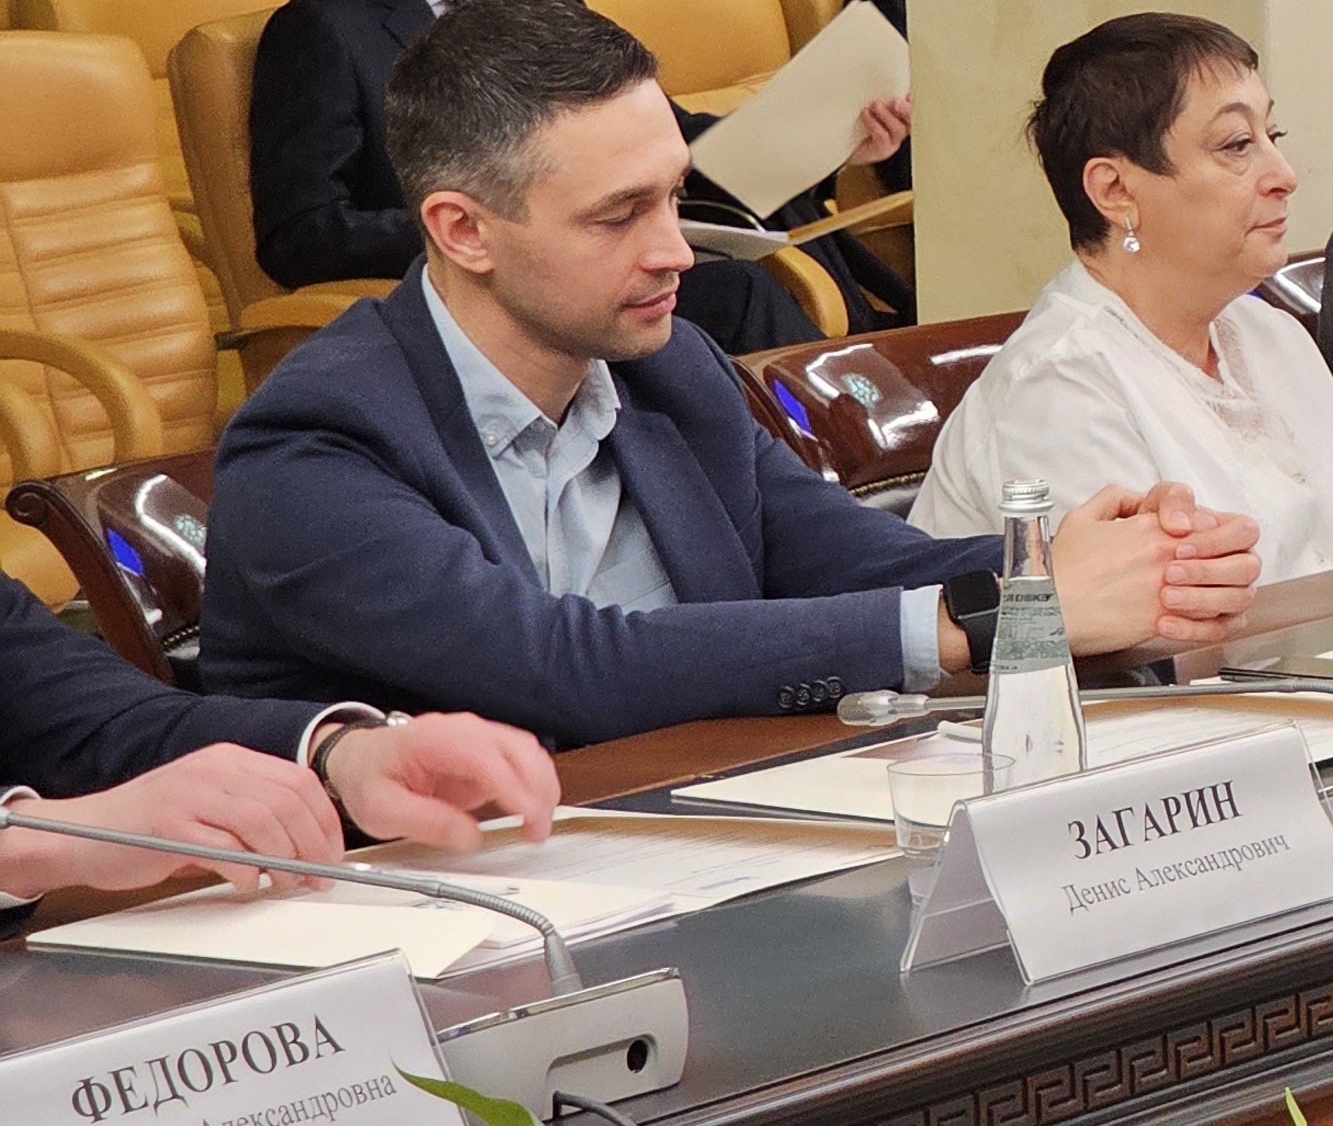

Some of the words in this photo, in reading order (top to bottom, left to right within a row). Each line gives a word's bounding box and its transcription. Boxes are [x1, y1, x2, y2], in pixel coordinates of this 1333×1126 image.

[1067, 779, 1243, 860] ЗАГАРИН
[1061, 878, 1131, 916] Денис
[1134, 834, 1291, 892] Александрович
[71, 1014, 345, 1124] ФЕДОРОВА
